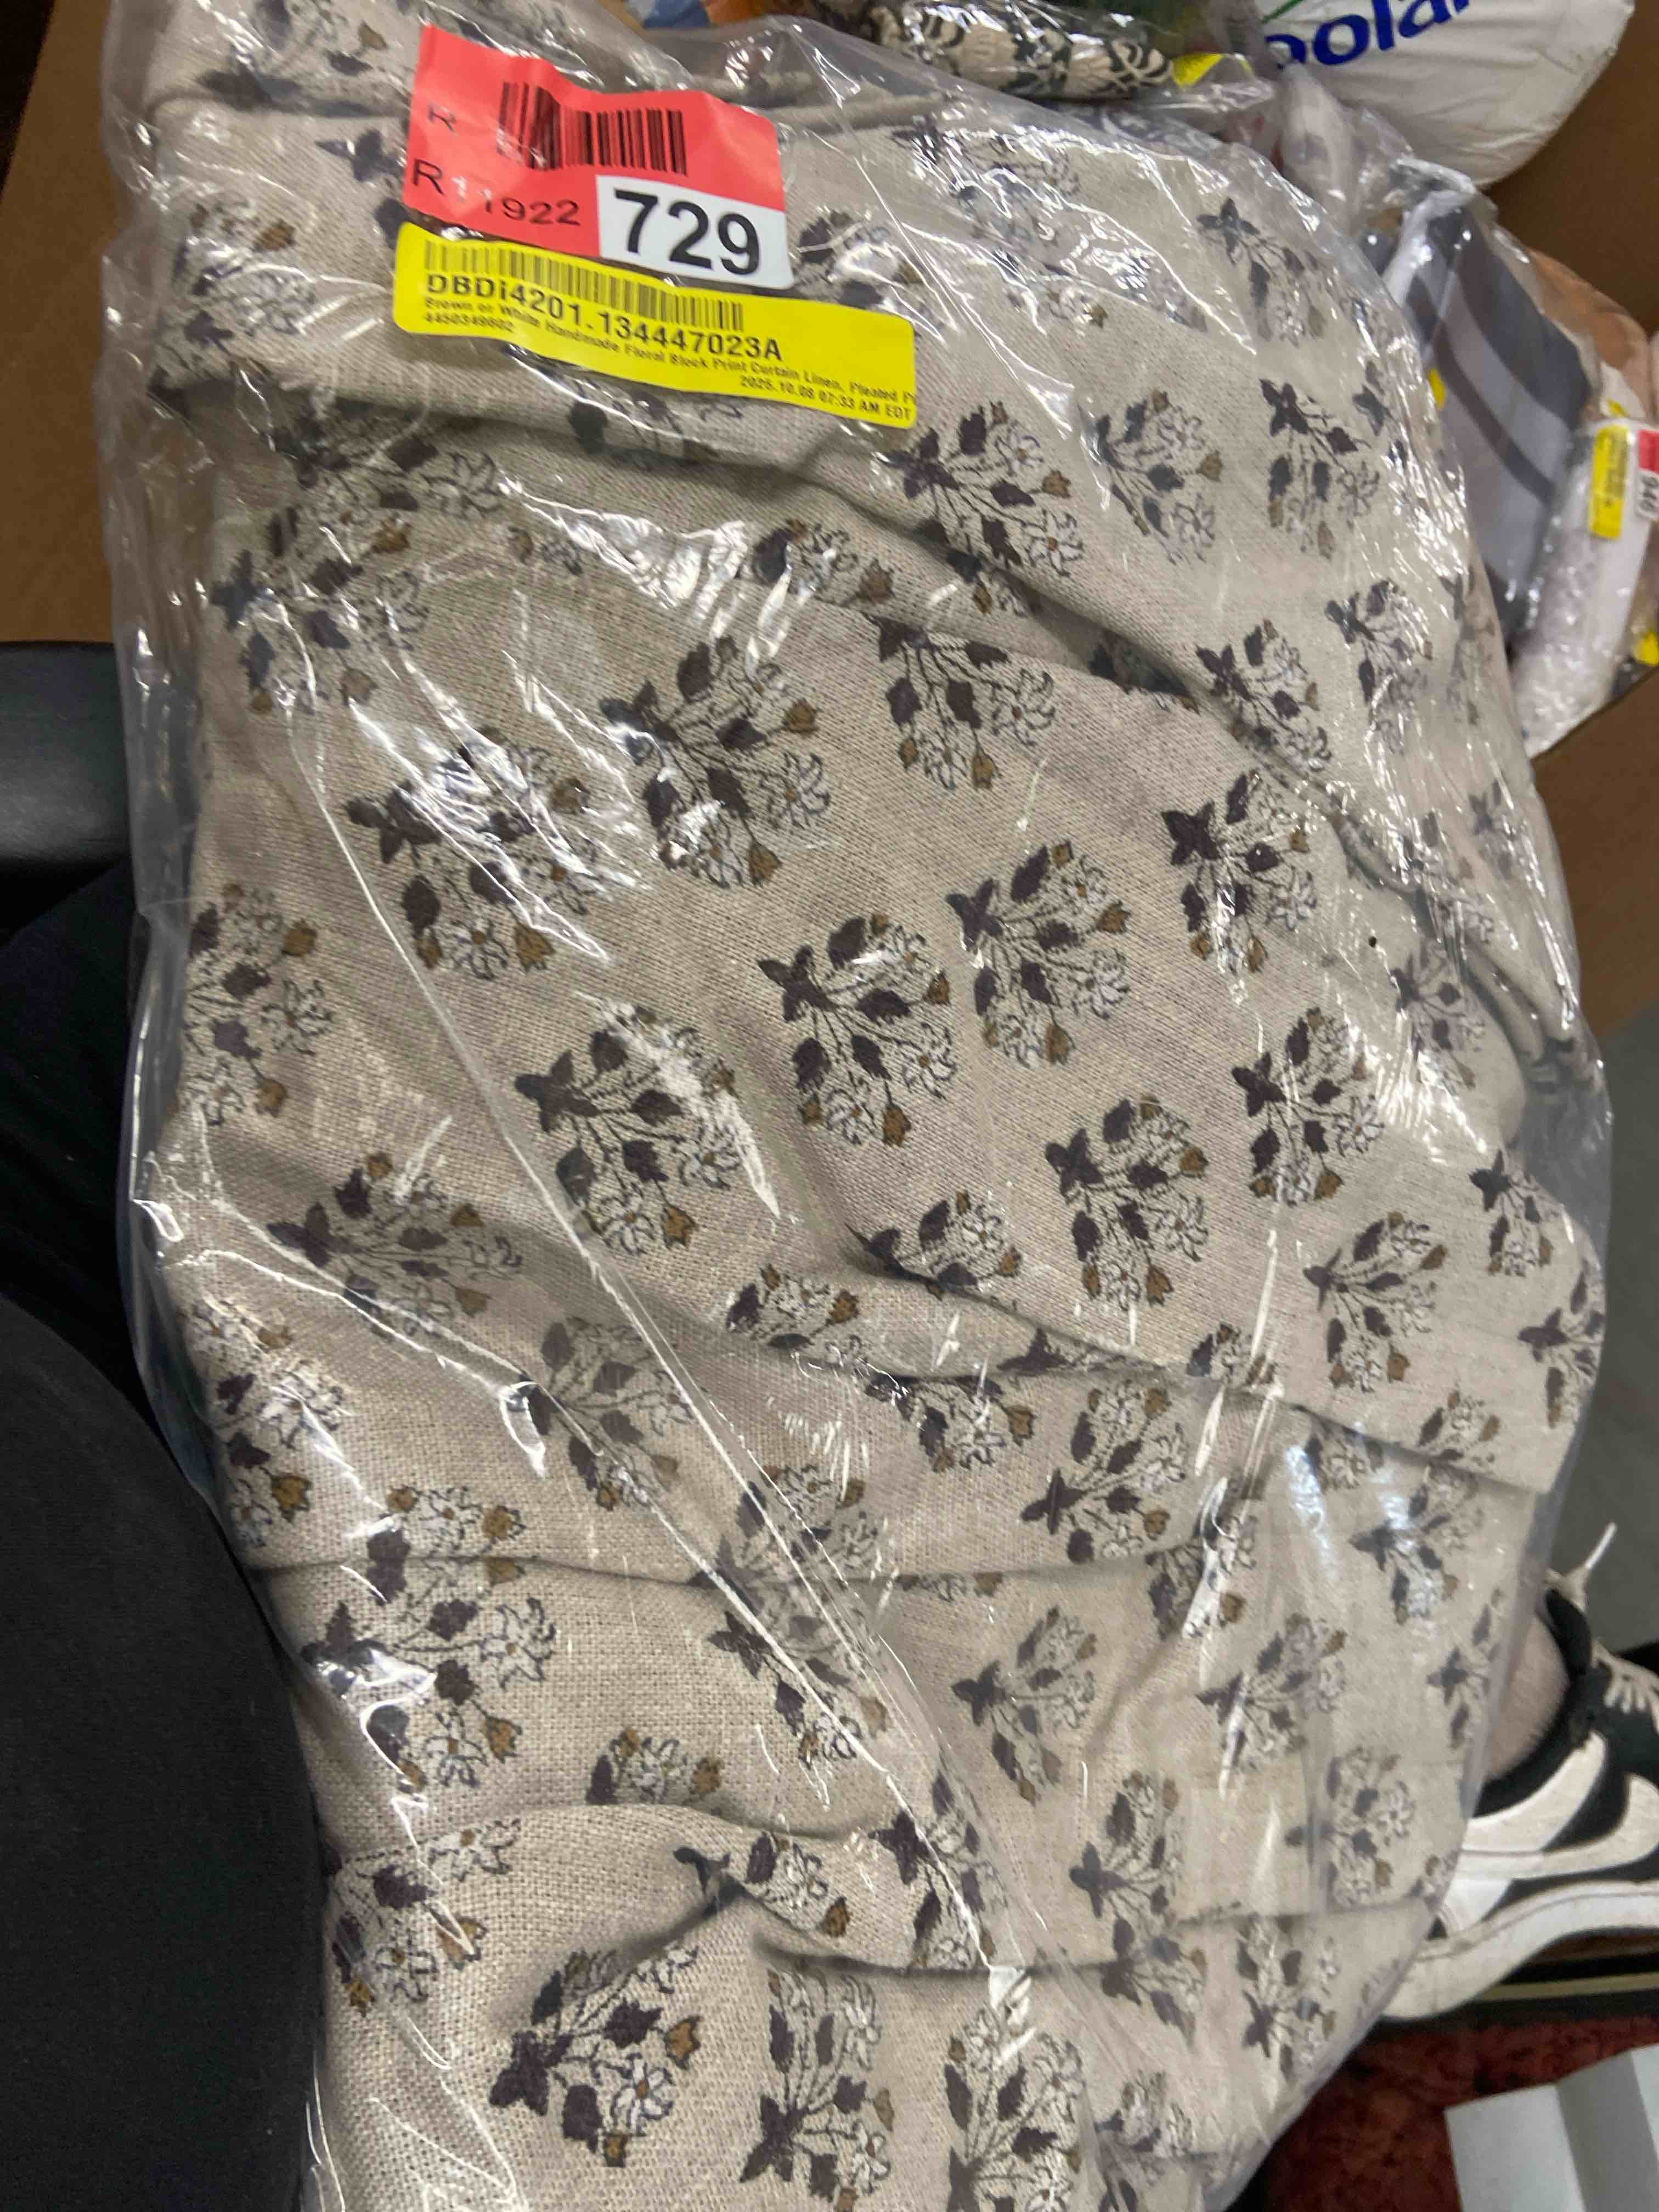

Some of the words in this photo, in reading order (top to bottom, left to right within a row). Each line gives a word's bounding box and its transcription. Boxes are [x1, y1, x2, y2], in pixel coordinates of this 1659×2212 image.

[614, 188, 759, 275] 729
[626, 343, 665, 363] Floral
[672, 354, 708, 368] Block
[713, 359, 747, 373] Print
[751, 362, 799, 380] Curtain
[850, 381, 898, 403] Pleated
[859, 398, 881, 415] AM
[885, 405, 912, 421] EDT
